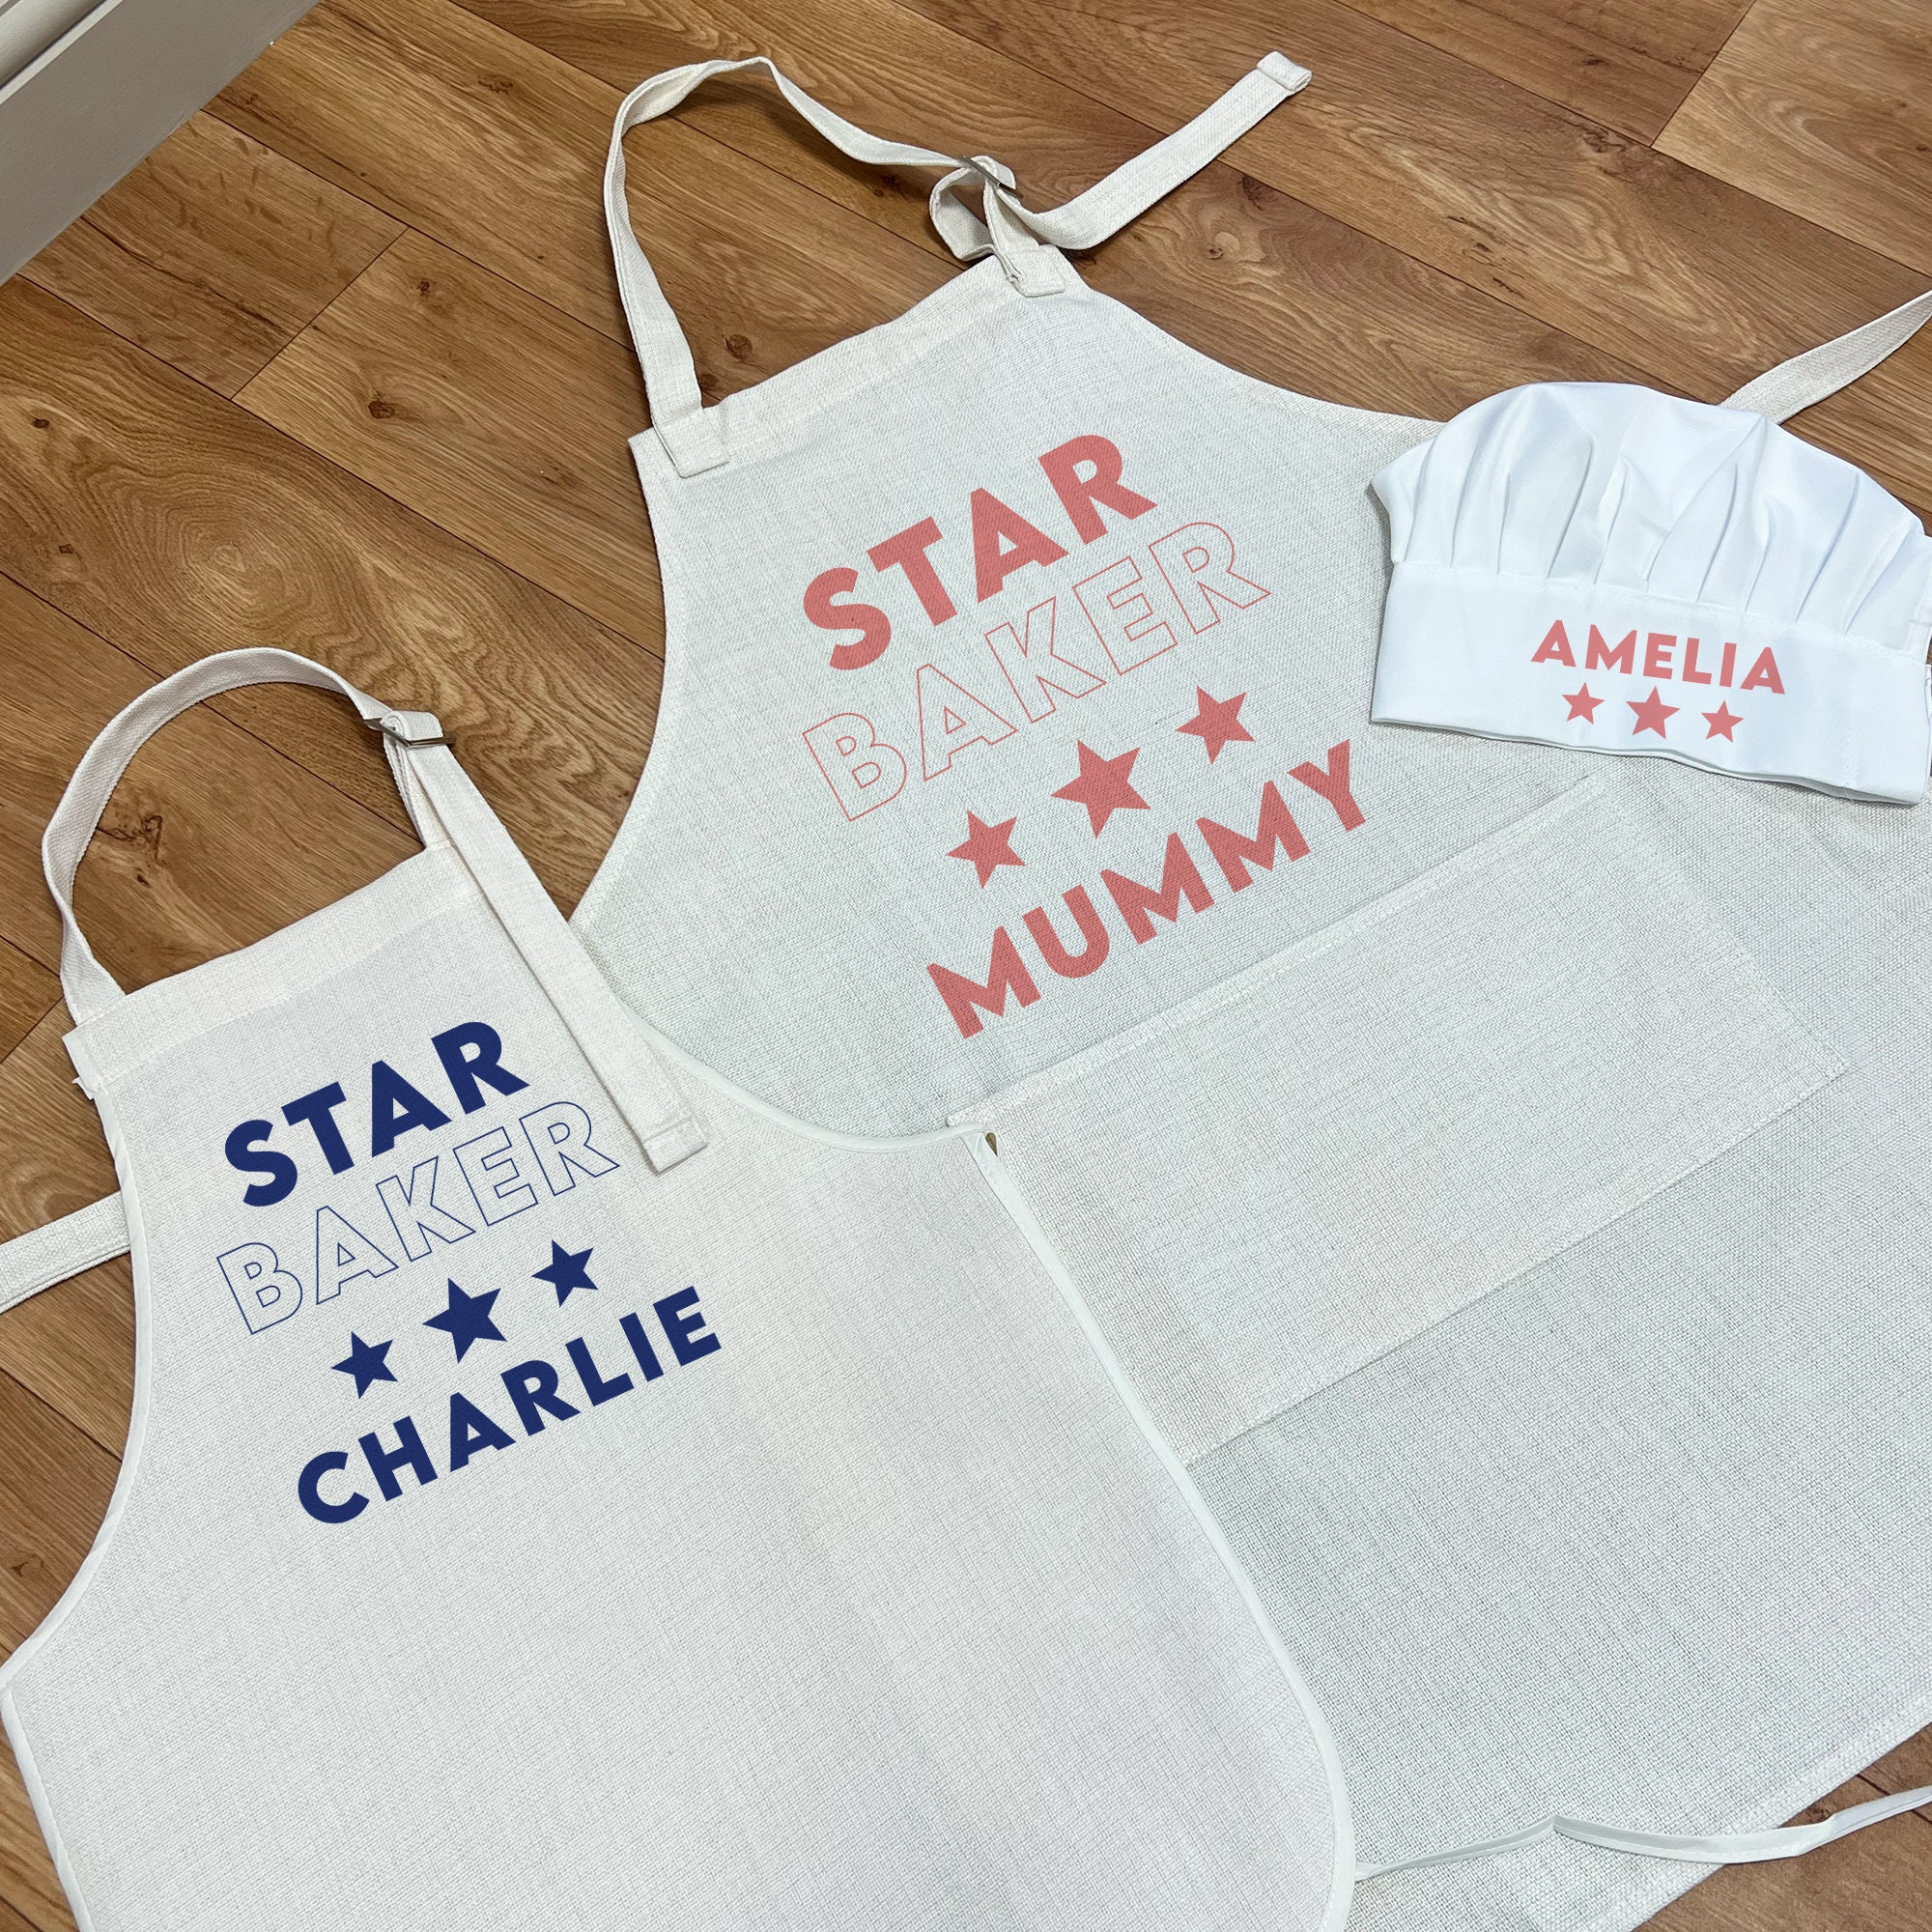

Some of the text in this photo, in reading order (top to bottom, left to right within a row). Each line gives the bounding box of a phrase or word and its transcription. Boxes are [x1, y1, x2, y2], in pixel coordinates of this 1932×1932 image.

[804, 435, 1157, 670] STAR
[1531, 620, 1785, 695] AMELIA
[803, 522, 1270, 821] BAKER
[927, 740, 1366, 1038] MUMMY
[216, 1101, 619, 1335] BAKER
[225, 1021, 529, 1207] STAR
[298, 1285, 722, 1524] CHARLIE
